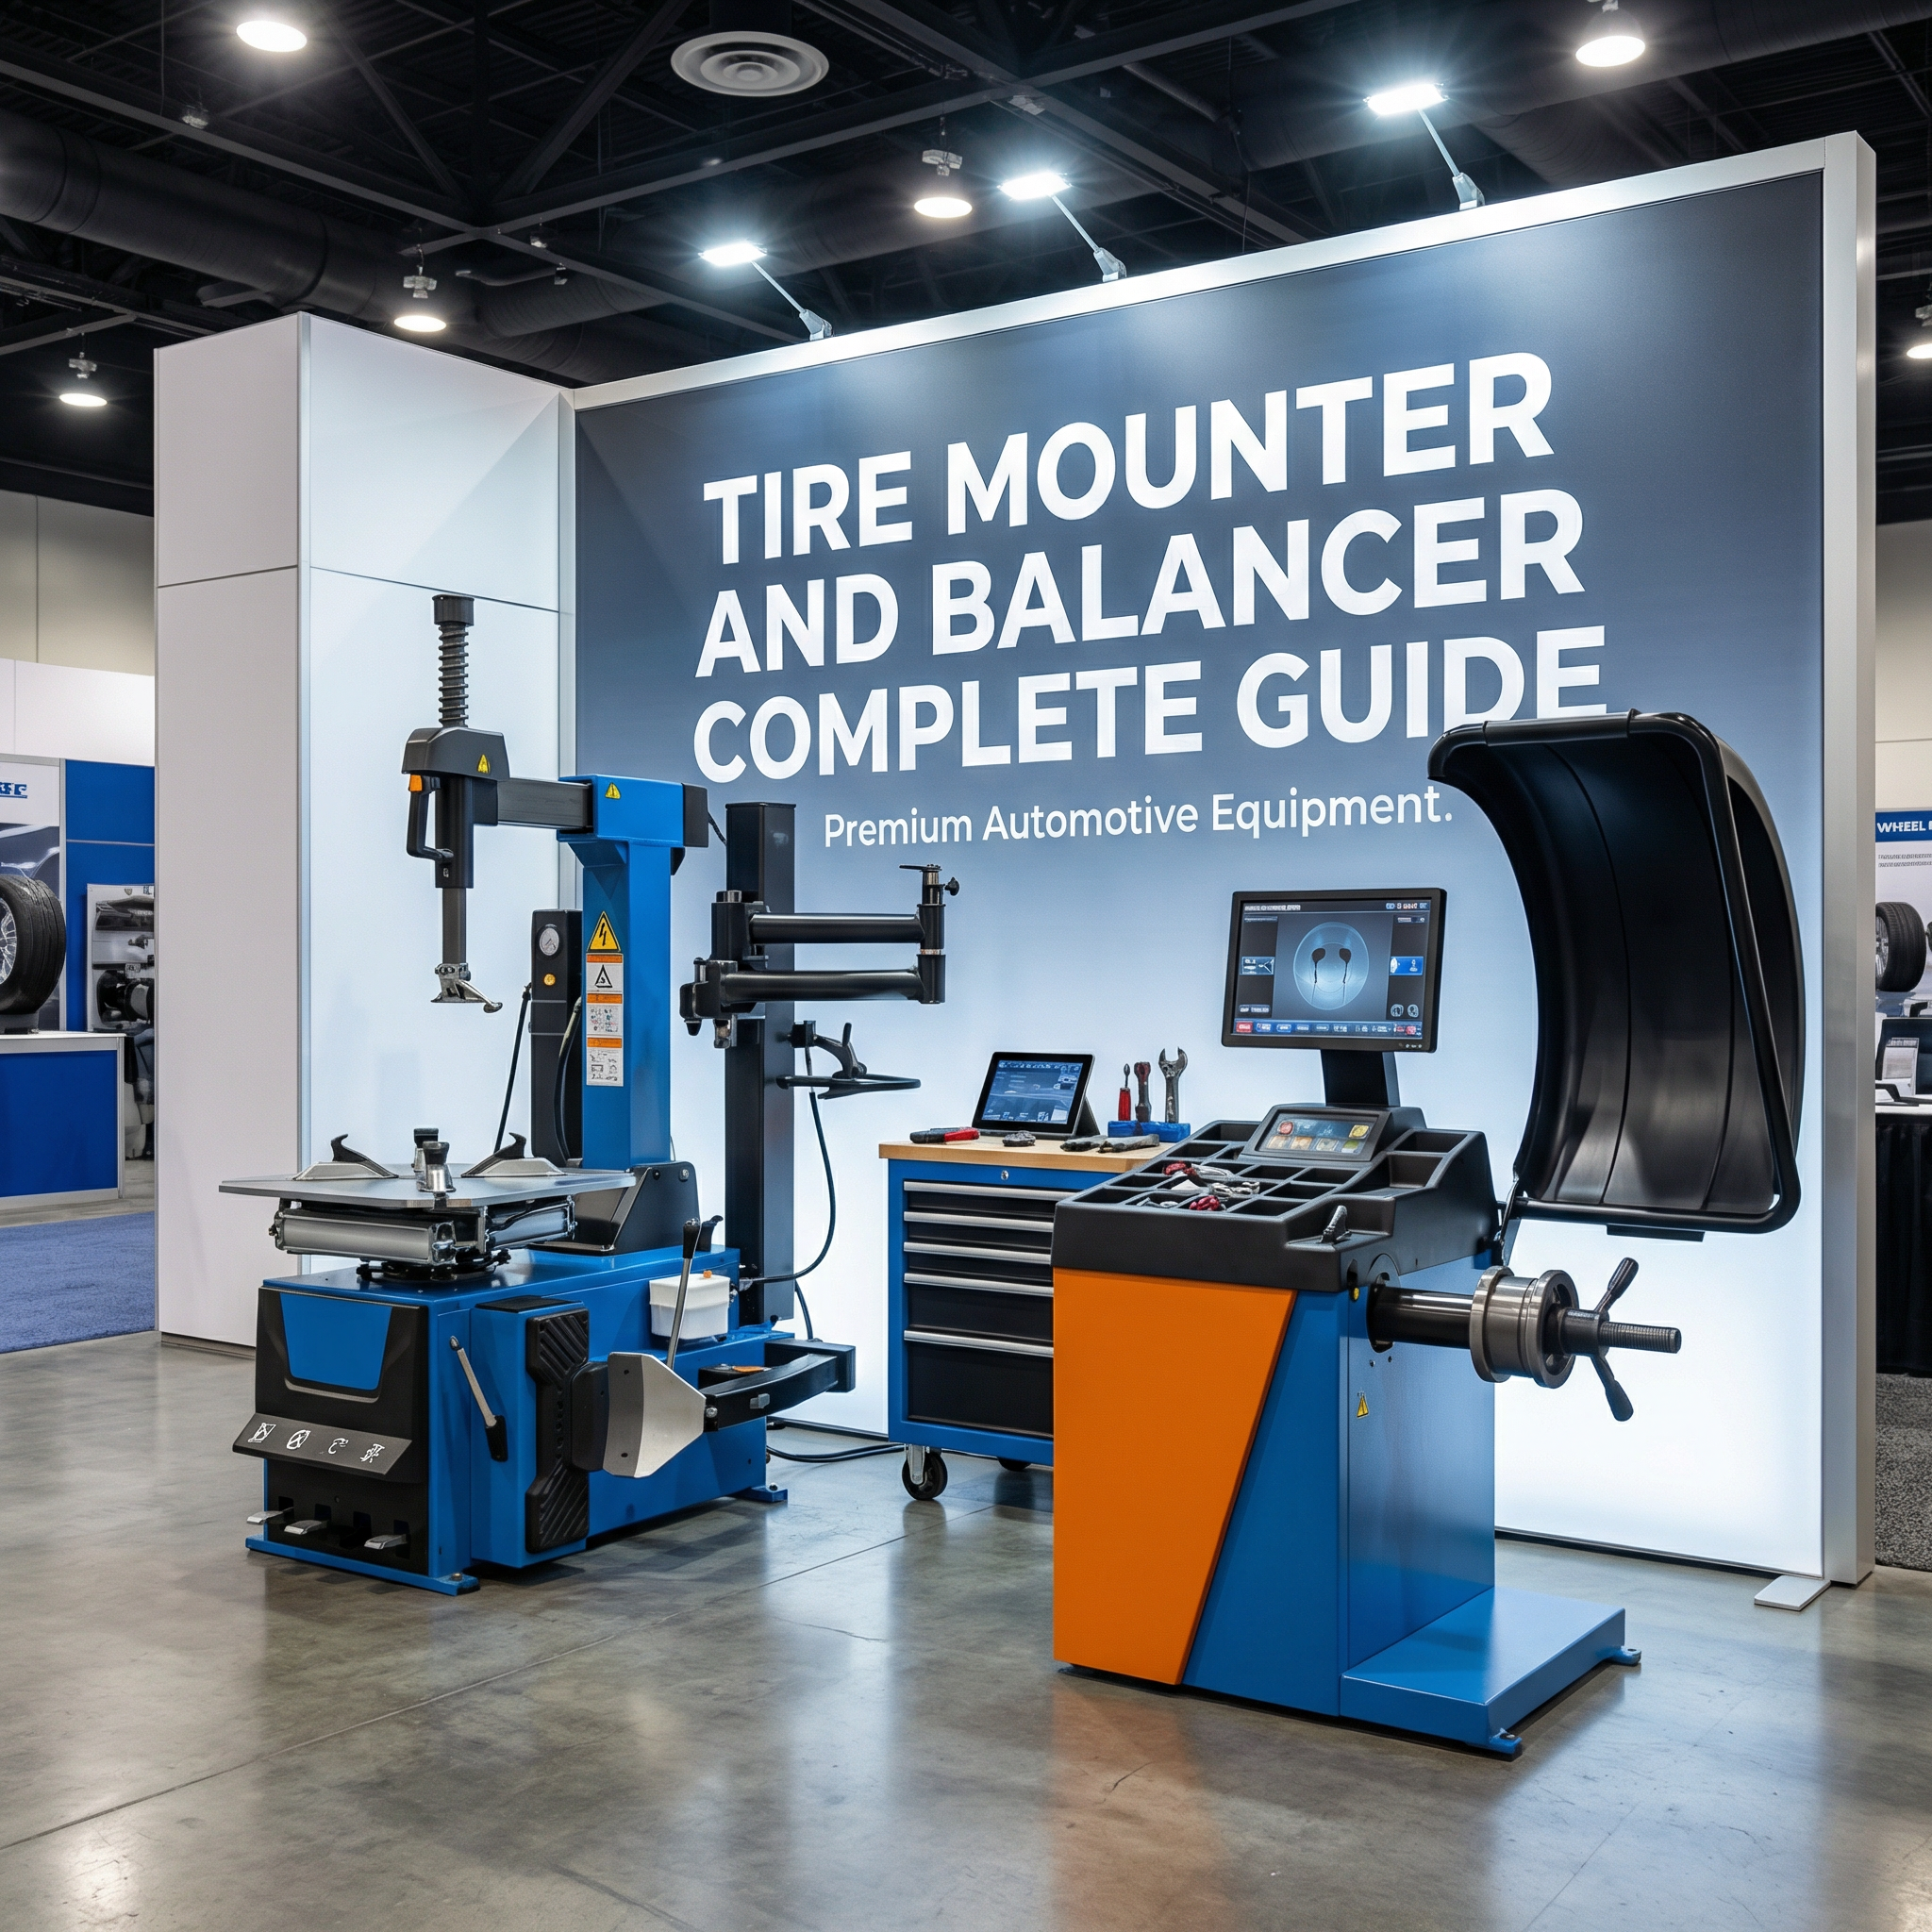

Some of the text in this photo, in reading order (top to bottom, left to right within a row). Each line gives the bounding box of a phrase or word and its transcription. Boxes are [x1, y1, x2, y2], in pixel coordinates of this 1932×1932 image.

[703, 352, 1555, 565] TIRE MOUNTER
[694, 489, 1586, 678] AND BALANCER
[693, 625, 1607, 784] COMPLETE GUIDE
[824, 785, 1453, 848] Premium Automotive Equipment.
[1877, 821, 1926, 833] WHEEL
